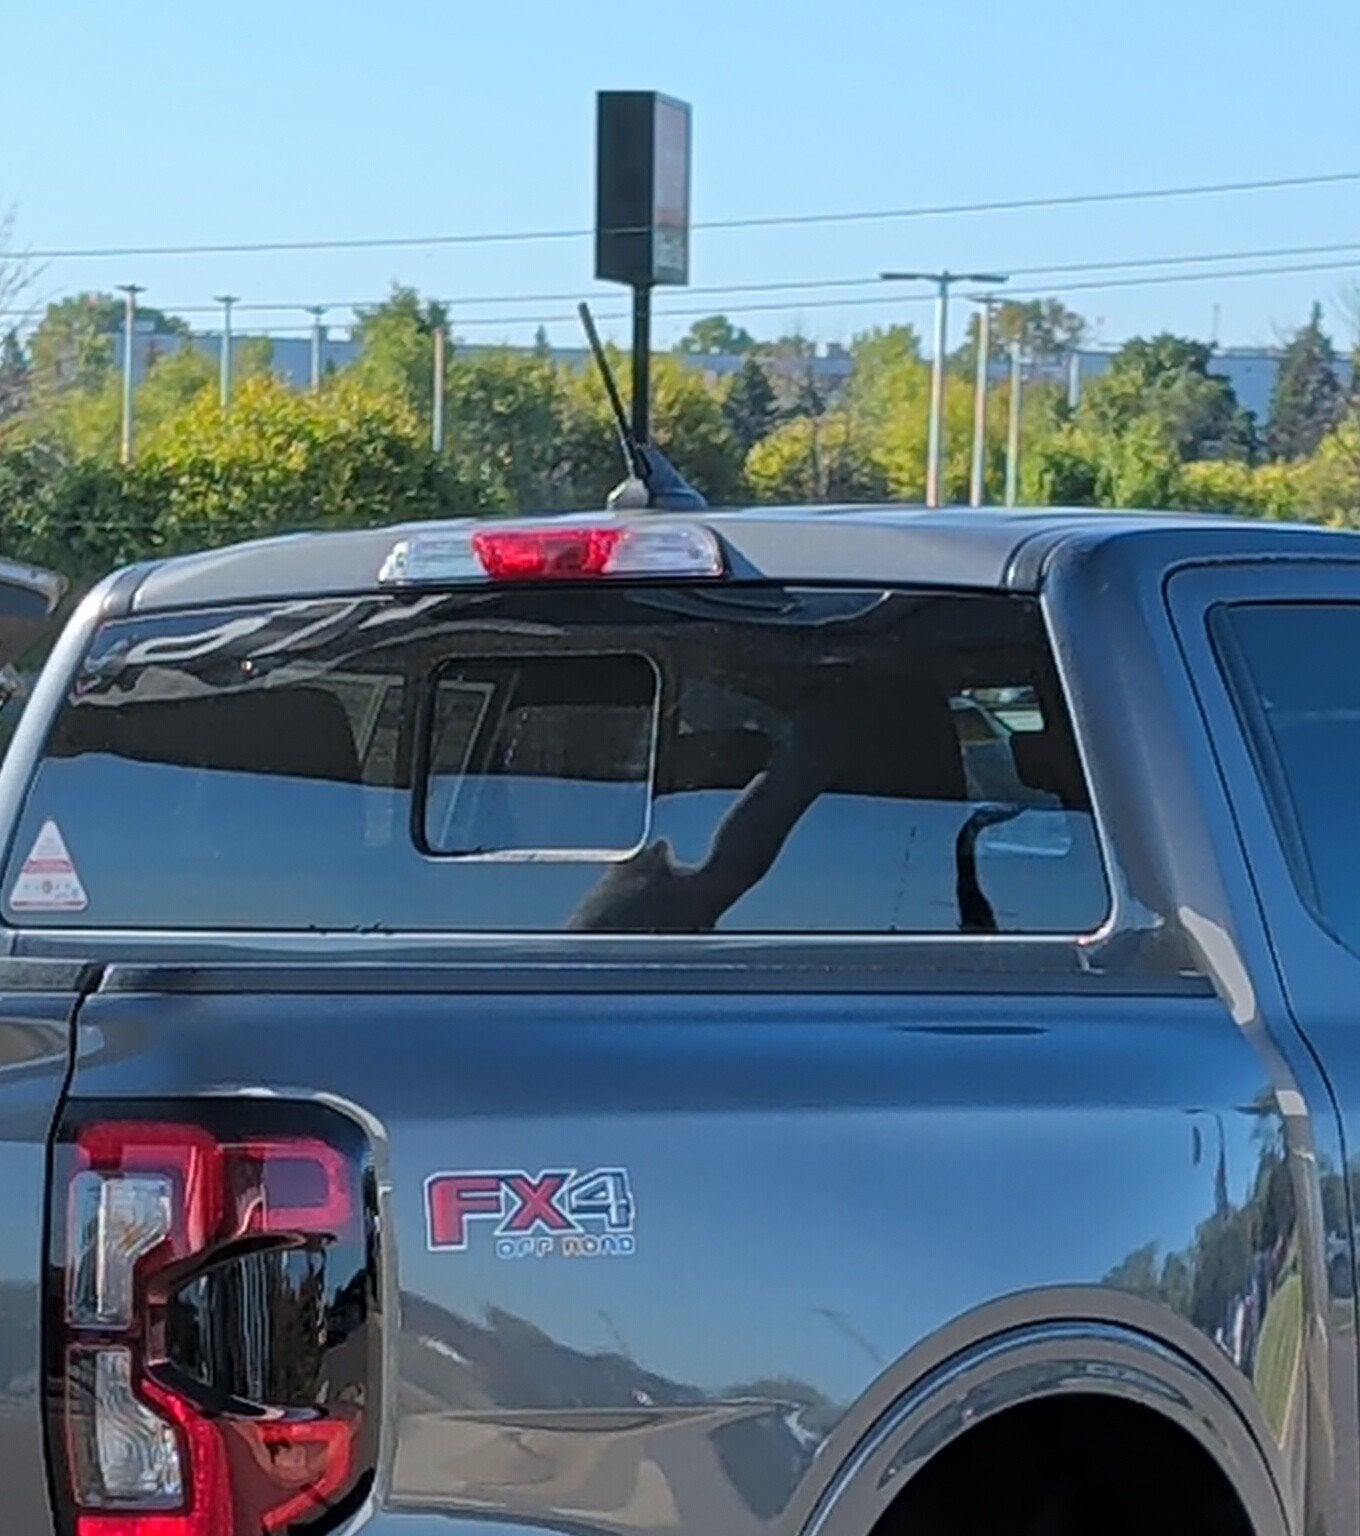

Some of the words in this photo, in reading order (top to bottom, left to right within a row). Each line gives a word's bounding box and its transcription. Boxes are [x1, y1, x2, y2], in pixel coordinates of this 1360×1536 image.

[423, 1167, 635, 1251] FX4
[496, 1237, 553, 1259] OFF
[562, 1234, 636, 1257] ROAD
